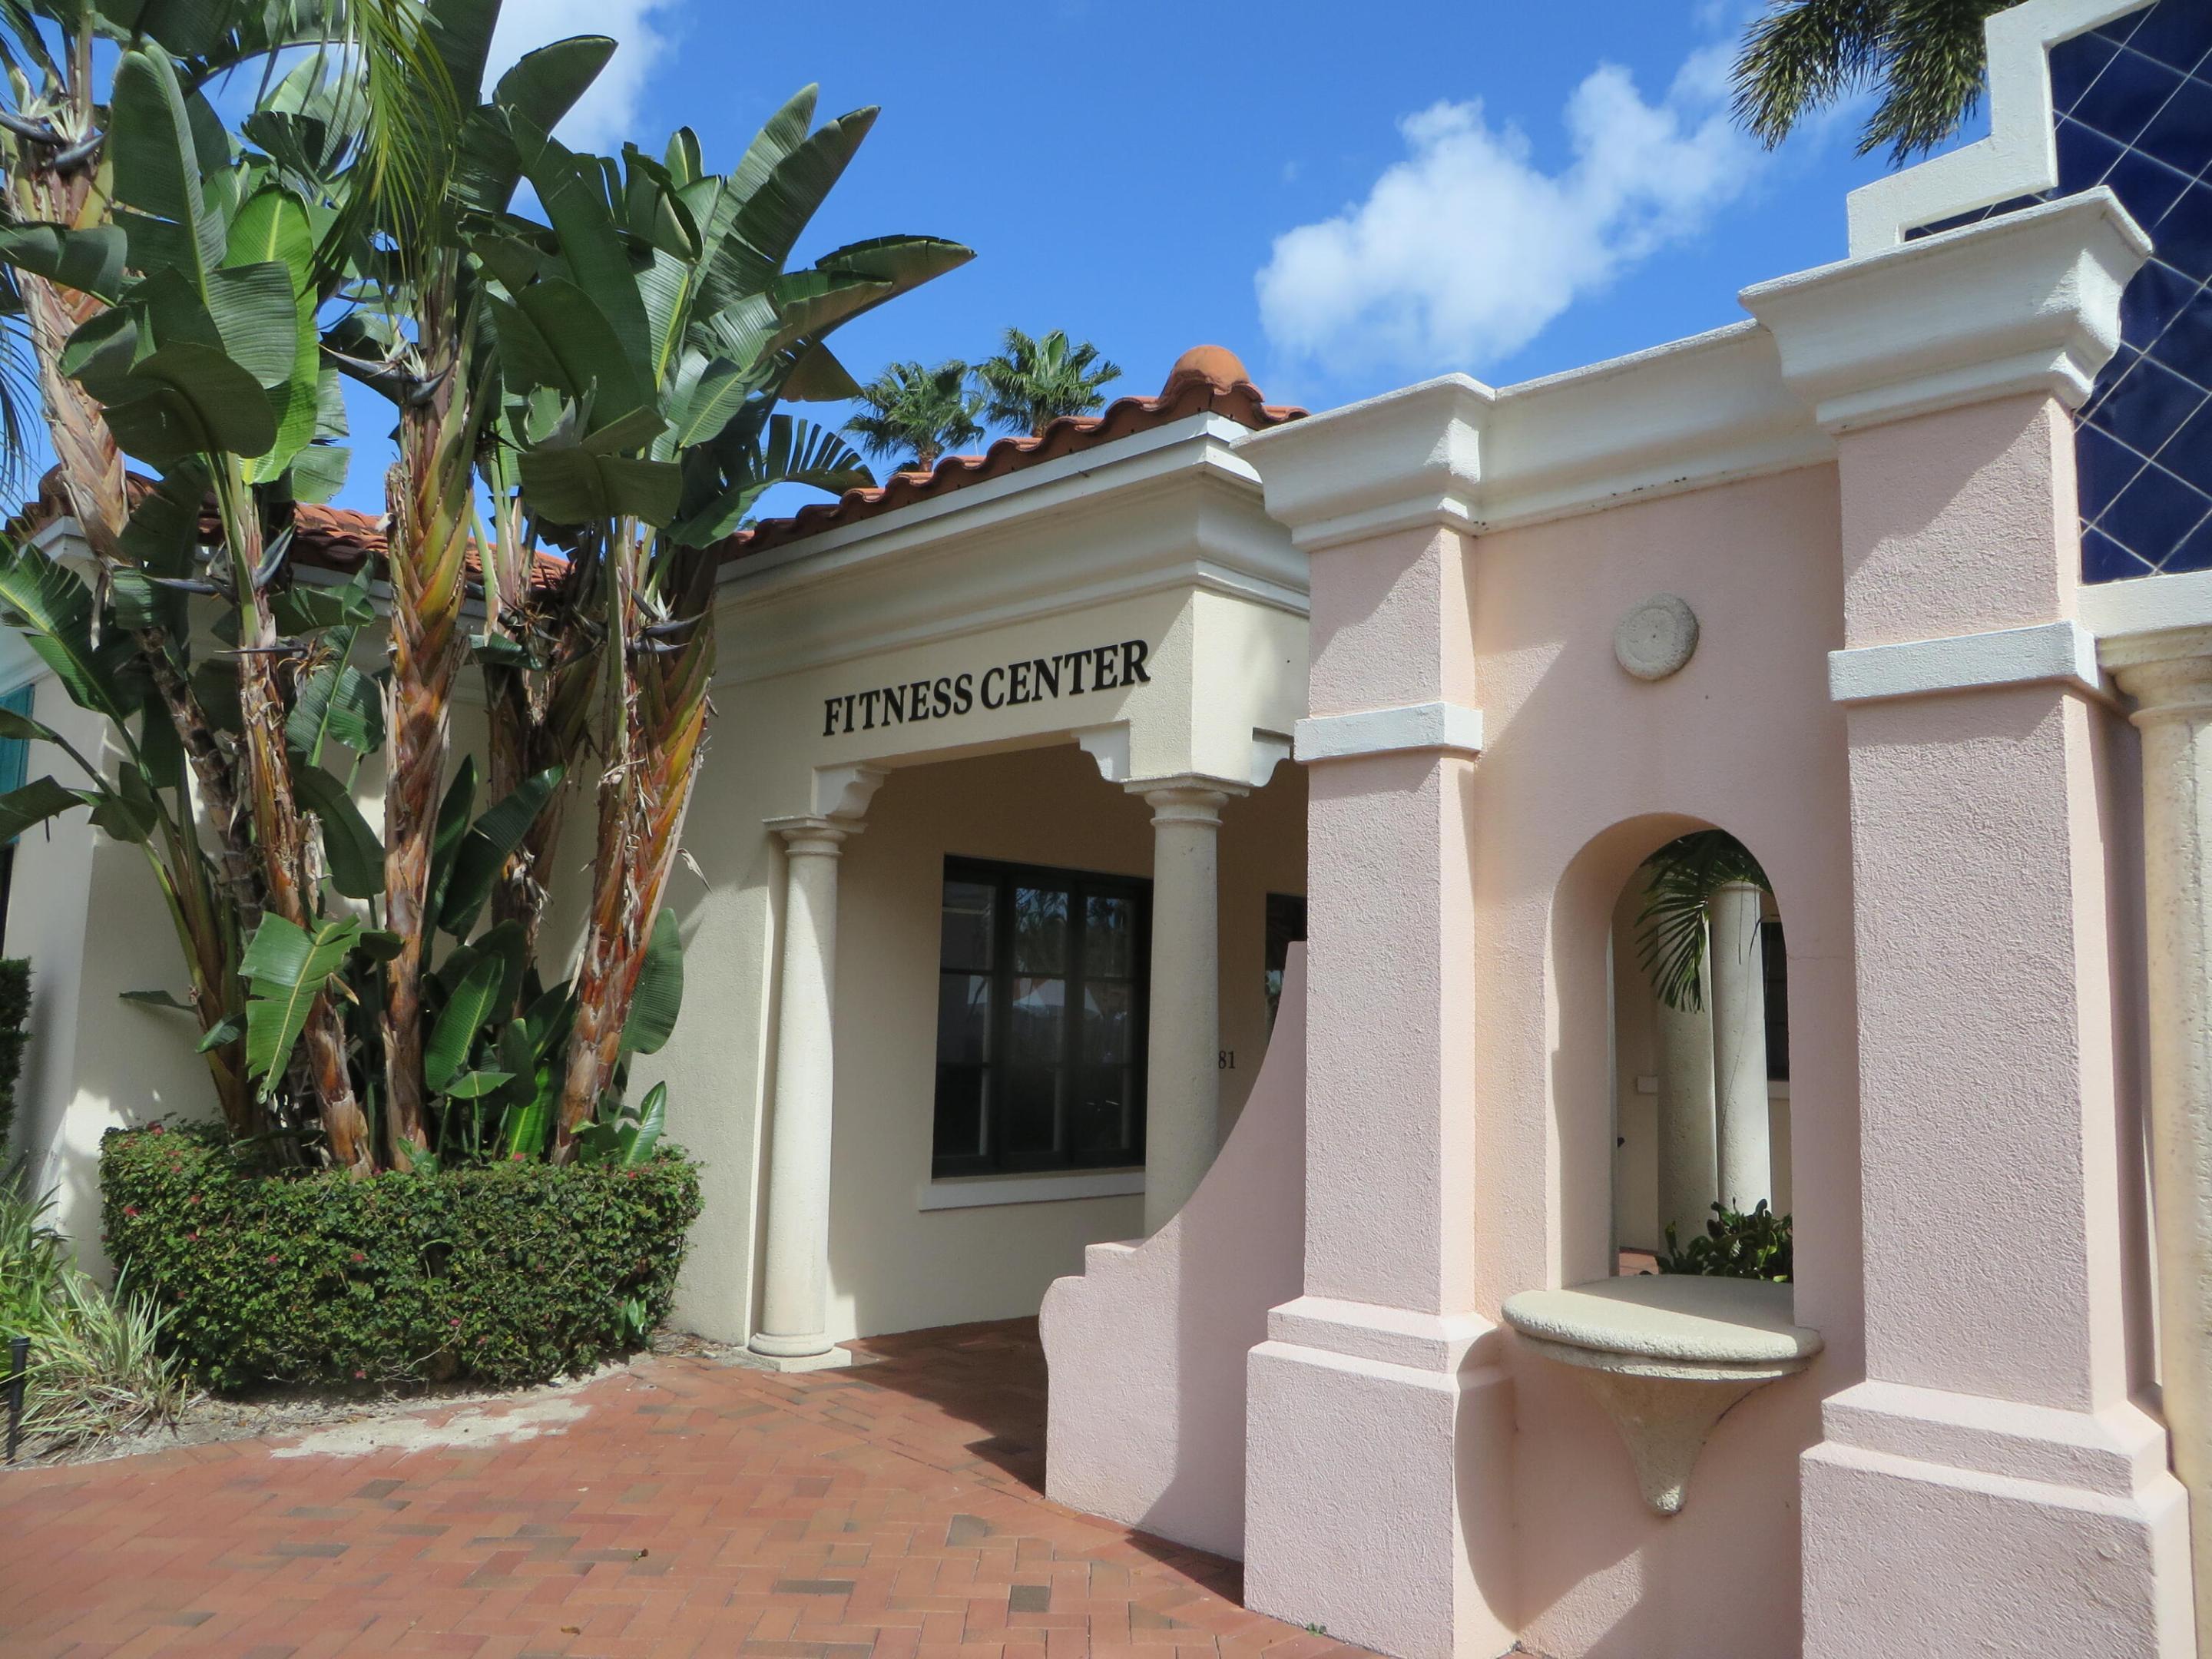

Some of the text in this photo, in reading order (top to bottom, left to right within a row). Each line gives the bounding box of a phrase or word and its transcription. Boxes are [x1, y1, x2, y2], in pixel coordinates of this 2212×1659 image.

[823, 639, 1151, 737] FITNESS CENTER
[1218, 1050, 1236, 1069] 81
